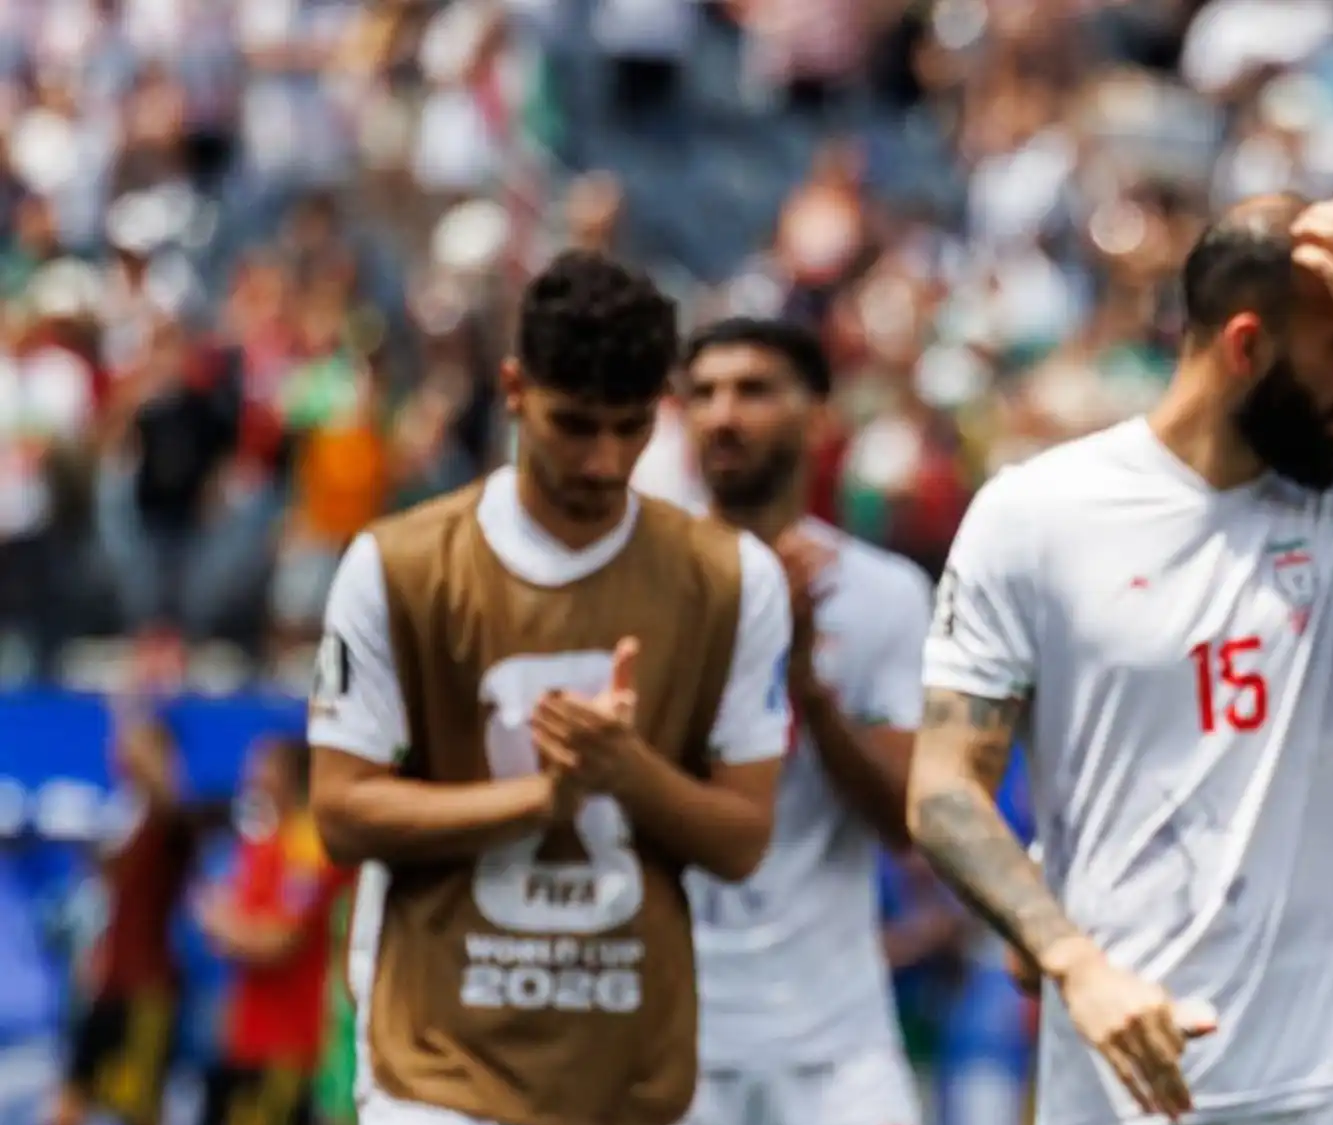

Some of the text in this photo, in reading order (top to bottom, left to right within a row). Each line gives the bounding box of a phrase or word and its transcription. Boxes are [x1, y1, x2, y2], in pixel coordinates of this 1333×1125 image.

[1187, 637, 1268, 734] 15
[466, 932, 580, 965] WORLD
[460, 964, 642, 1013] 2026
